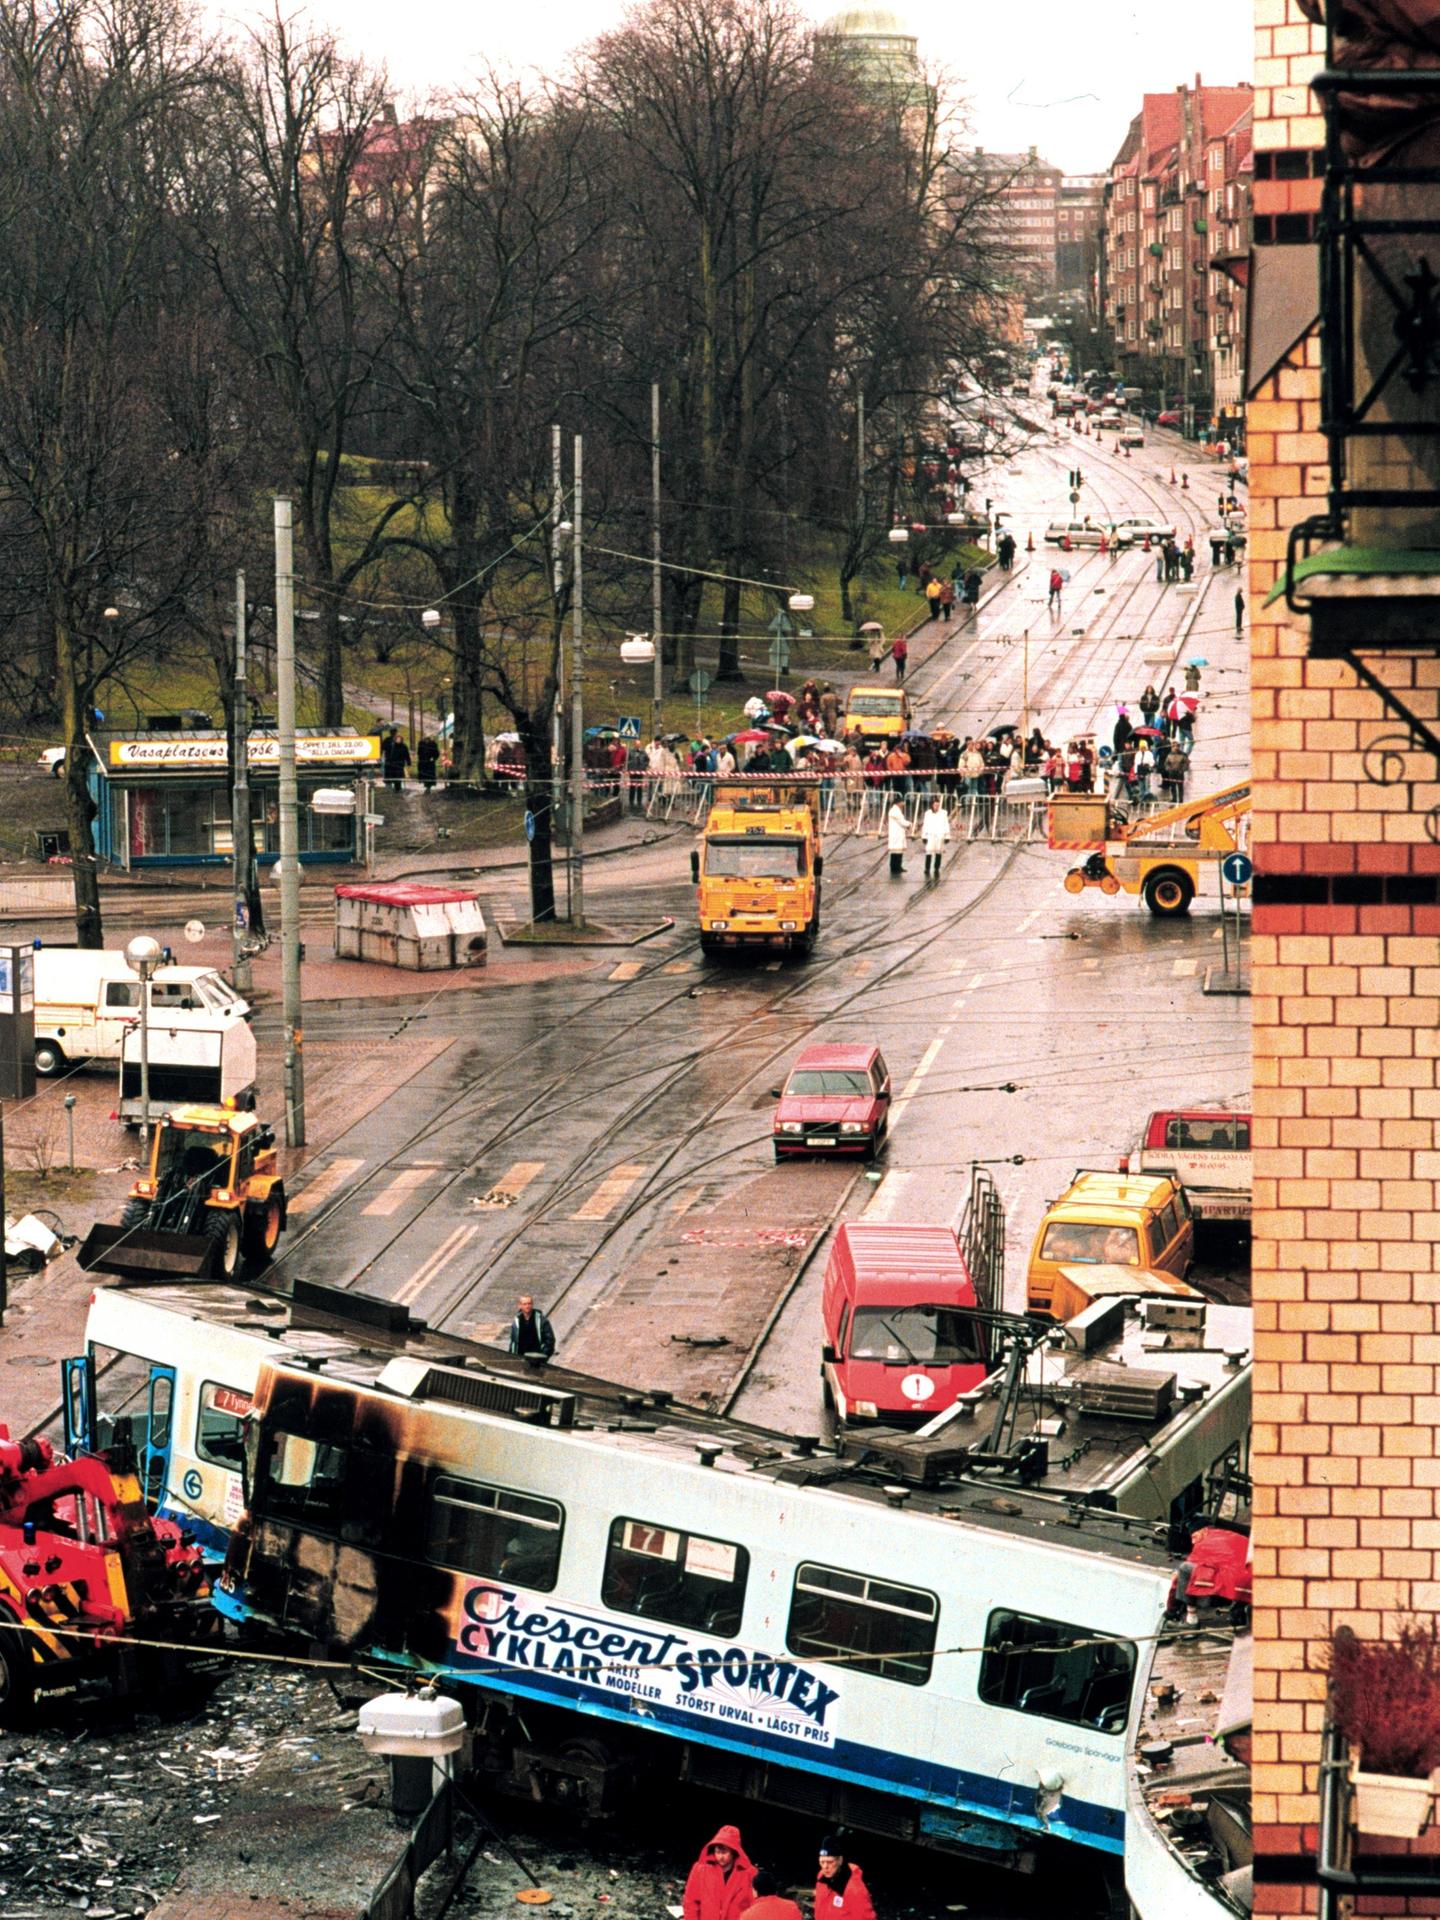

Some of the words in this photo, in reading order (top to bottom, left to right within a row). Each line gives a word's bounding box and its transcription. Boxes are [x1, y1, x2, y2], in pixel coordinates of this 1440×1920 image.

[127, 742, 224, 758] Vasaplatsens
[642, 1527, 656, 1552] 7
[464, 1586, 688, 1673] Crescent
[460, 1624, 603, 1685] CYKLAR
[606, 1658, 641, 1680] ÅRETS
[605, 1675, 662, 1700] MODELLER
[675, 1648, 840, 1727] SPORTEX
[675, 1693, 716, 1714] STÖRST
[719, 1705, 754, 1725] URVAL
[767, 1715, 801, 1736] LÄGST
[804, 1726, 830, 1743] PRIS
